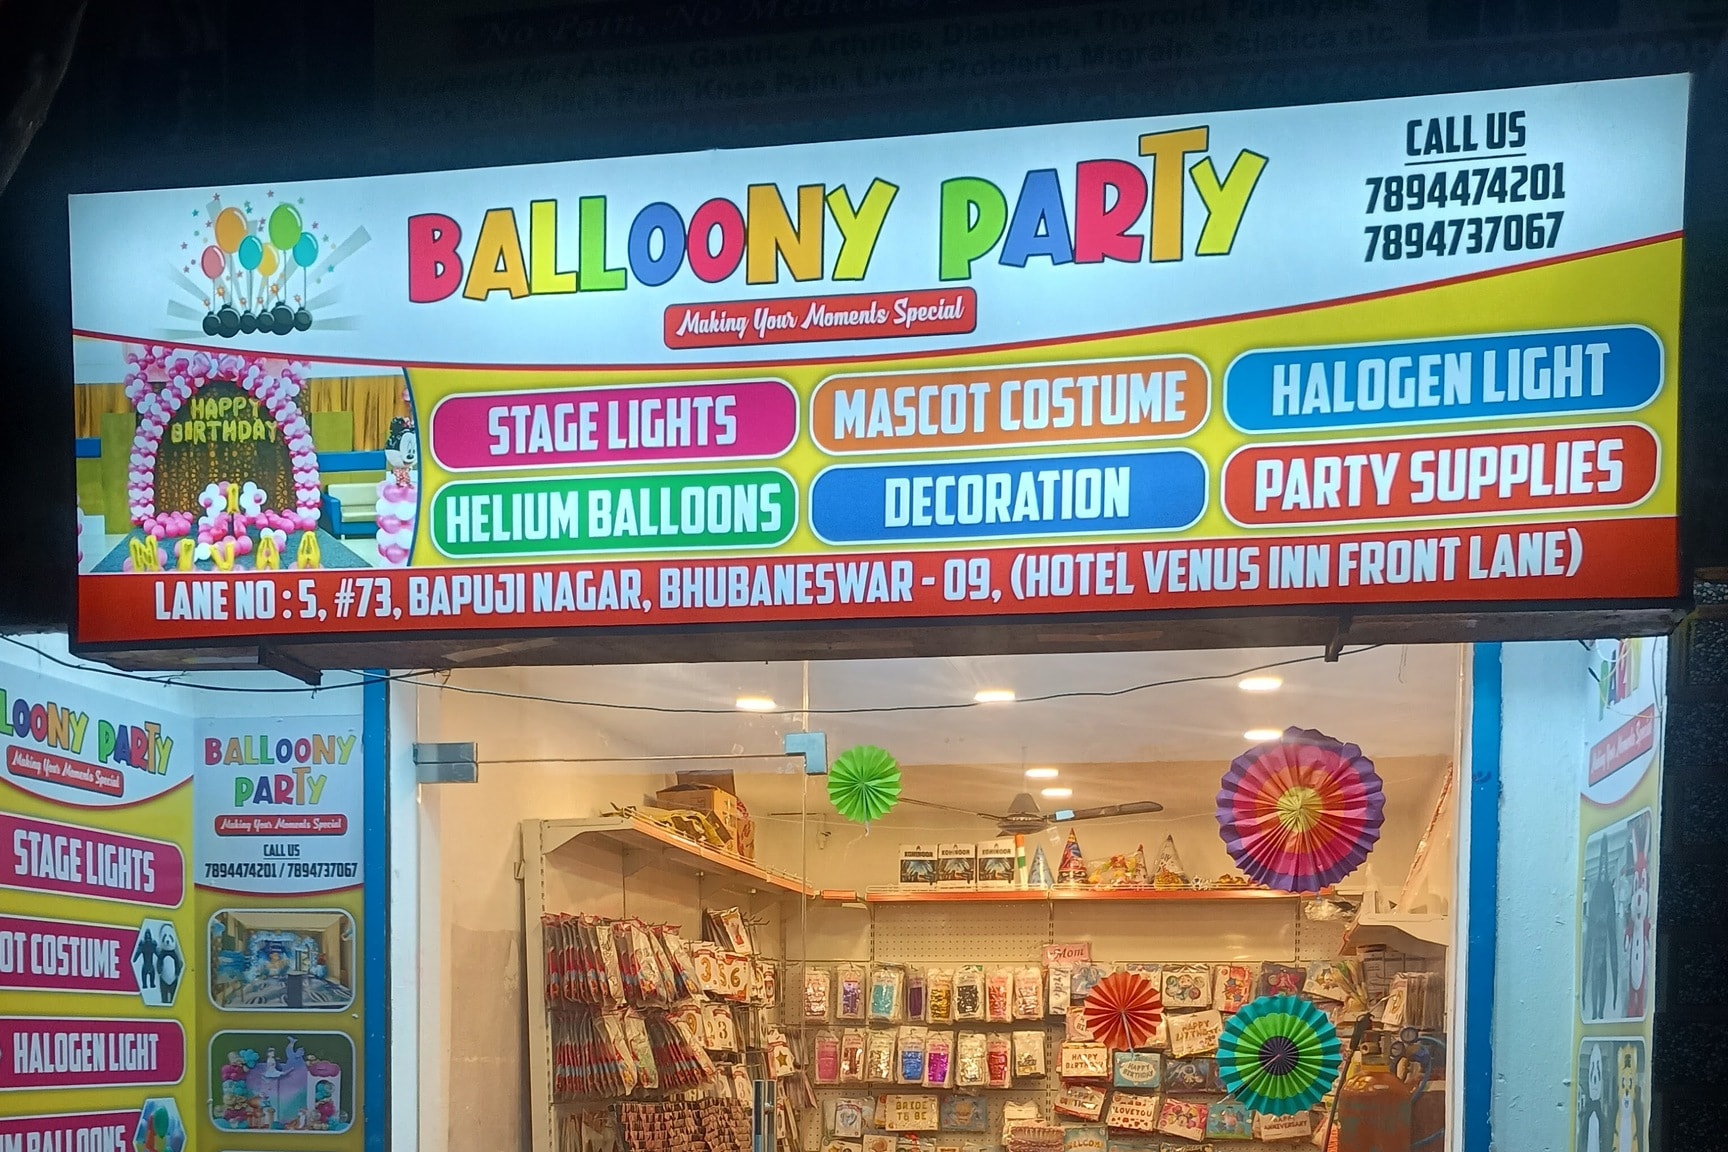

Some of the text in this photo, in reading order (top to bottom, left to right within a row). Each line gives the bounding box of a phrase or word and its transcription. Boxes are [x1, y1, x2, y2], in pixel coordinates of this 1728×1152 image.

[1406, 110, 1526, 156] CALL US
[1365, 162, 1565, 214] 7894474201
[408, 125, 1269, 303] BALLOONY PARTY
[1364, 211, 1565, 262] 7894737067
[676, 296, 965, 339] Making Your Moments Special
[1272, 342, 1610, 417] HALOGEN LIGHT
[190, 397, 260, 420] HAPPY
[488, 395, 737, 455] STAGE LIGHTS
[834, 370, 1187, 439] MASCOT COSTUME
[171, 420, 277, 445] BIRTHDAY
[885, 466, 1130, 528] DECORATION
[1255, 438, 1624, 511] PARTY SUPPLIES
[446, 482, 782, 543] HELIUM BALLOONS
[155, 580, 228, 620] LANE
[236, 580, 275, 620] NO
[298, 579, 327, 623] 5,
[334, 577, 403, 621] #73,
[408, 573, 525, 617] BAPUJI
[532, 569, 652, 613] NAGAR,
[659, 560, 913, 609] BHUBANESWAR
[944, 558, 1001, 604] 09,
[1010, 551, 1134, 600] (HOTEL
[1143, 546, 1260, 593] VENUS
[1268, 544, 1330, 589] INN
[1338, 537, 1461, 587] FRONT
[1468, 527, 1584, 580] LANE)
[12, 750, 120, 788] Making Your Moments Special
[98, 719, 173, 776] PARTY
[205, 734, 356, 765] BALLOONY
[234, 766, 327, 807] PARTY
[220, 818, 342, 832] Making Your Moments Special
[14, 829, 155, 893] STAGE LIGHTS
[205, 863, 276, 878] 7894474201
[288, 863, 358, 877] 7894737067
[263, 844, 300, 857] CALL US
[30, 933, 120, 979] COSTUME
[13, 1032, 159, 1074] HALOGEN LIGHT
[896, 1101, 927, 1110] BRIDE
[897, 1112, 927, 1120] TO BE
